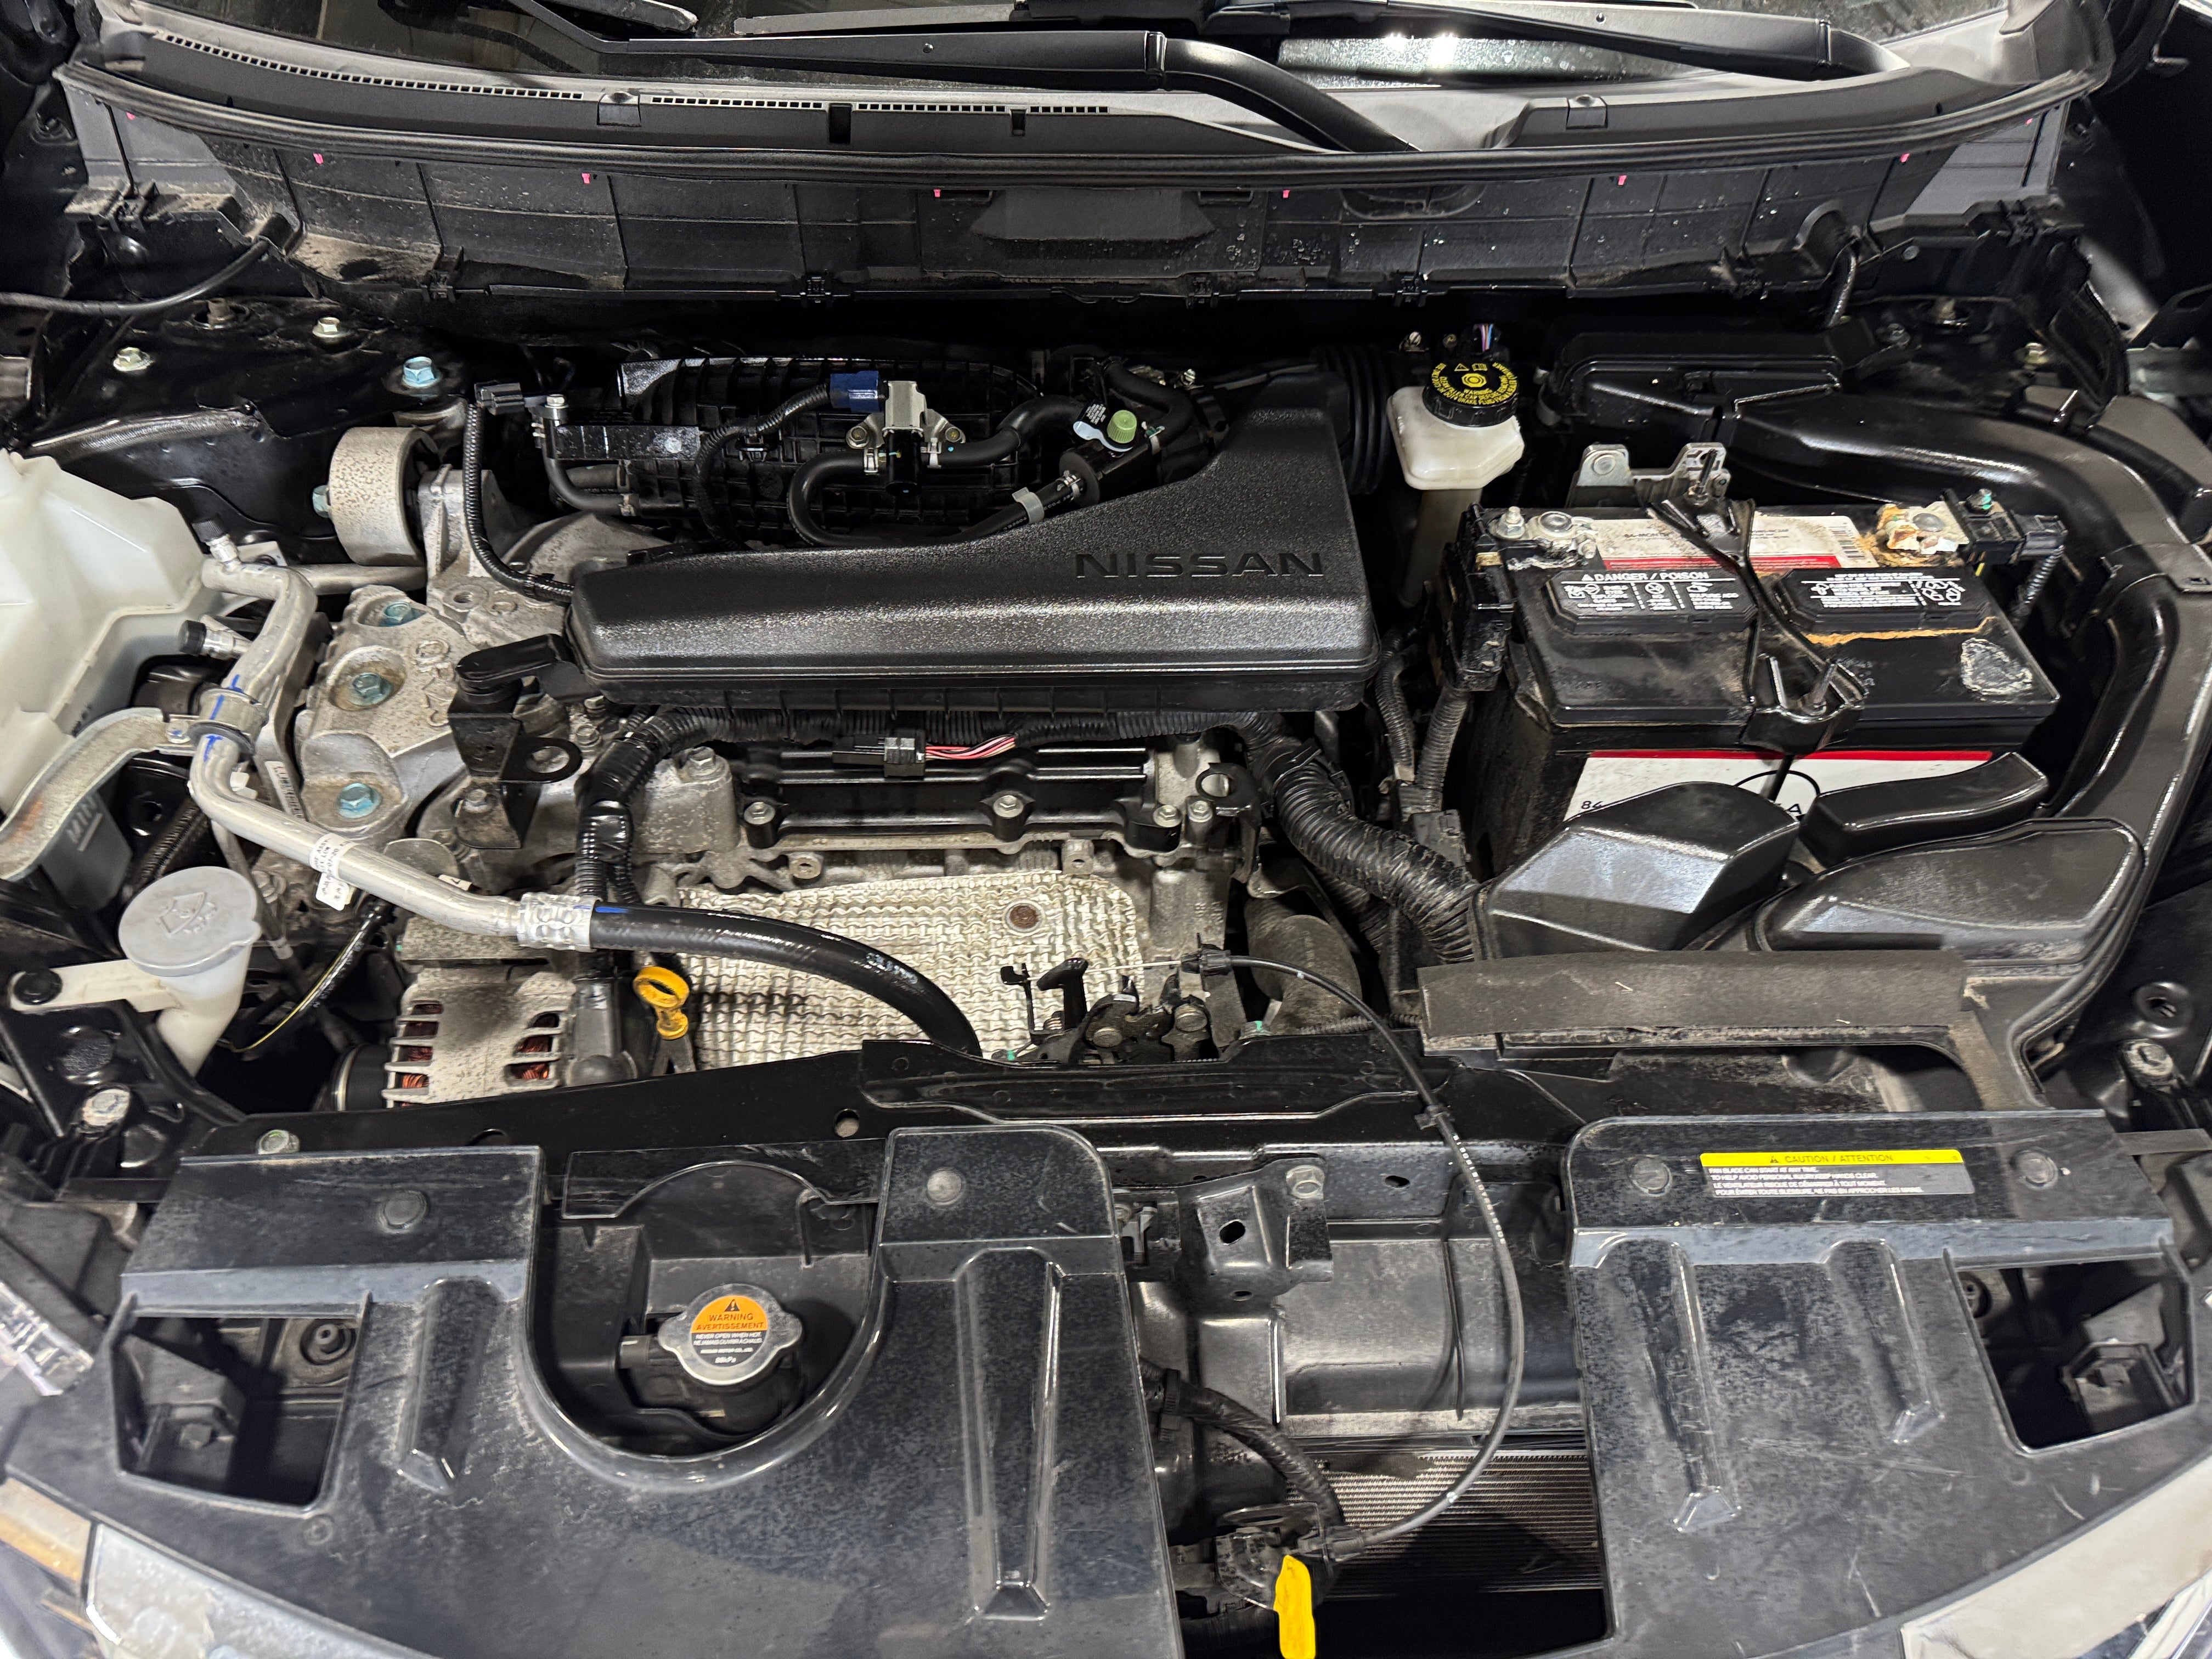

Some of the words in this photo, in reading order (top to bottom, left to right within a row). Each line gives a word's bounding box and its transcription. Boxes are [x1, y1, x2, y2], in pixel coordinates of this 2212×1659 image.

[1076, 552, 1324, 578] NISSAN
[1594, 573, 1648, 582] DANGER
[1660, 572, 1709, 580] POISON
[1784, 1155, 1829, 1163] CAUTION
[709, 1313, 754, 1322] WARNING
[696, 1322, 764, 1330] AVERTISSEMENT
